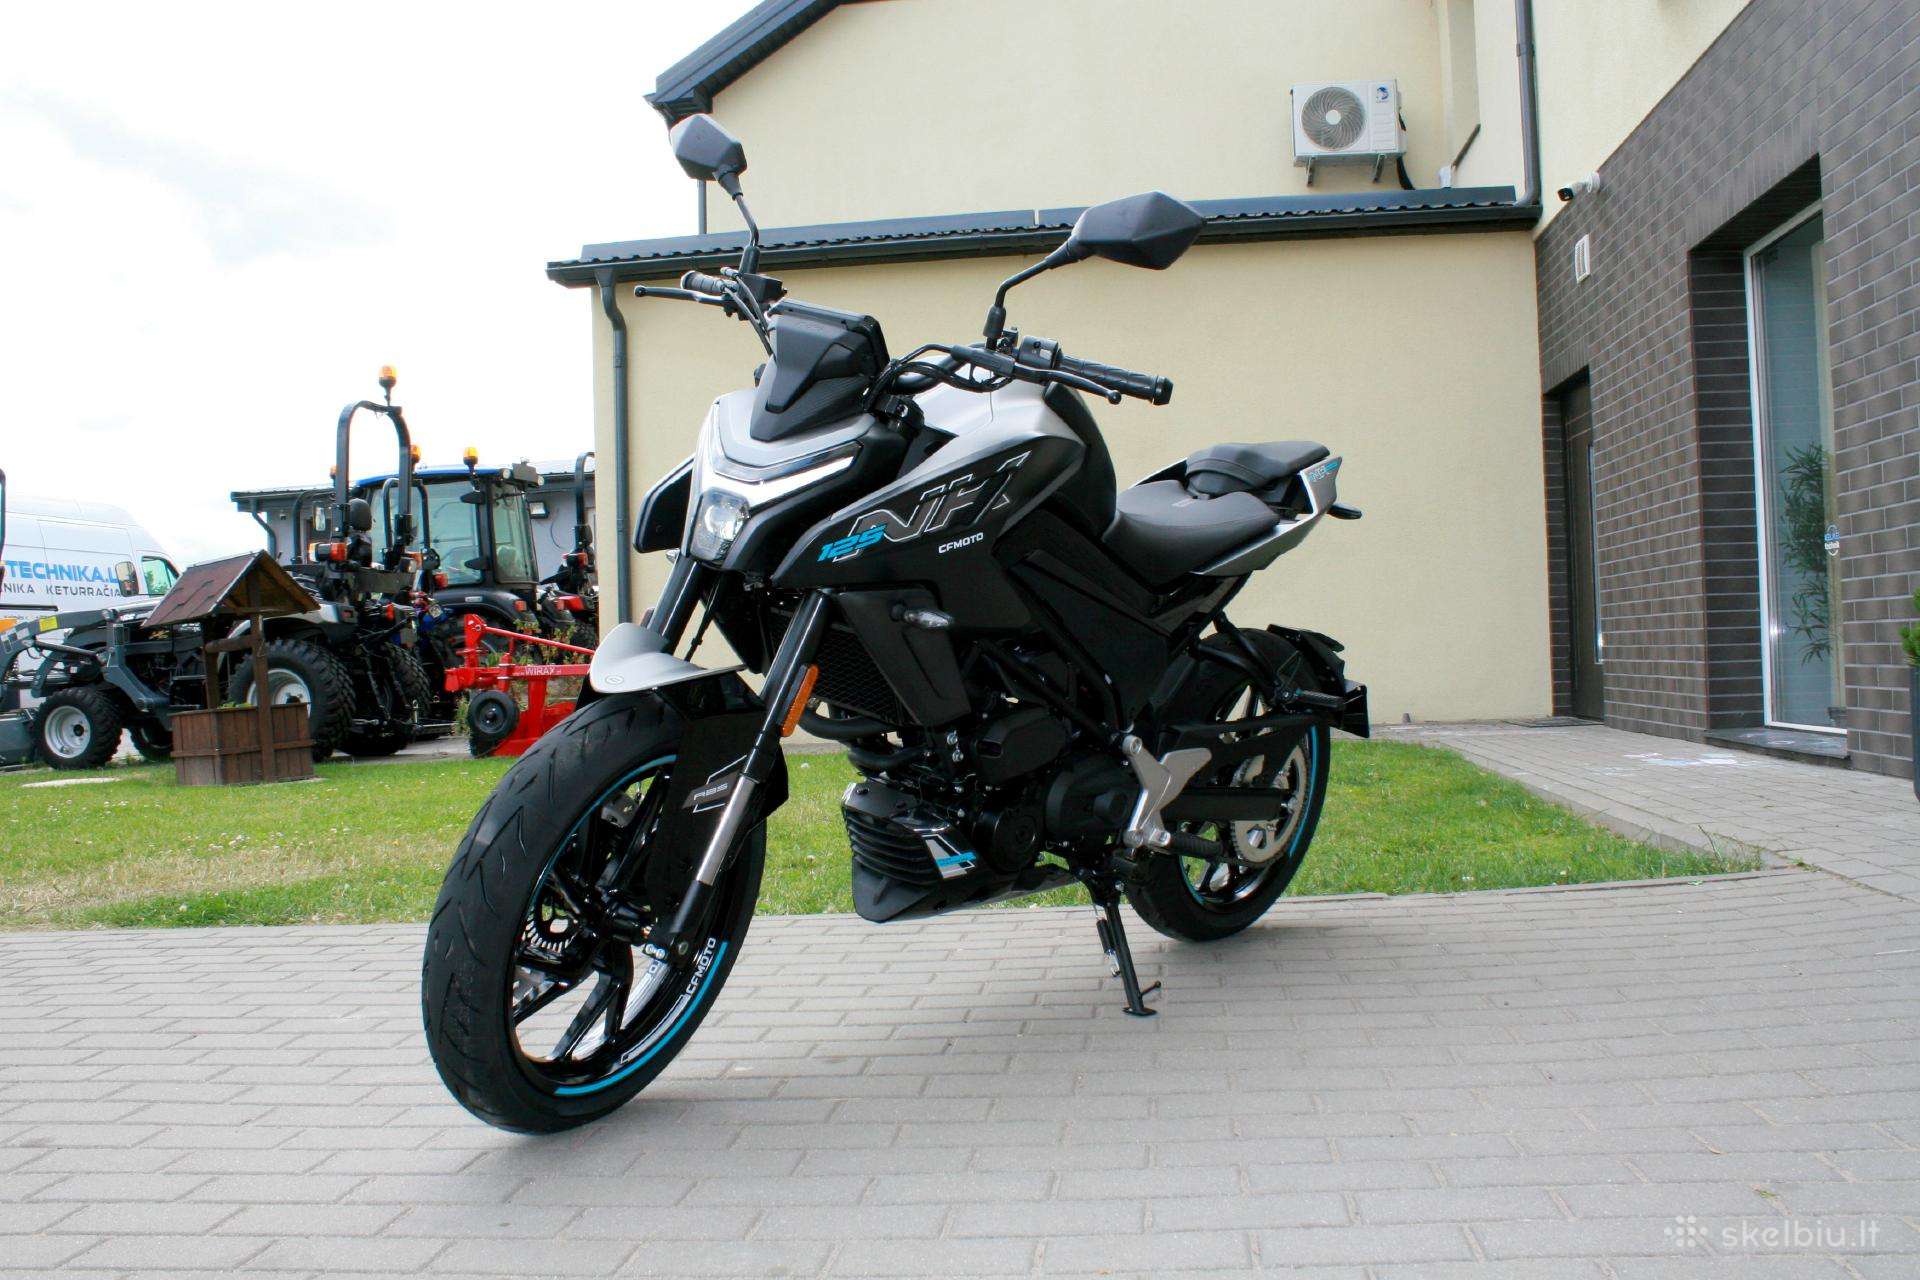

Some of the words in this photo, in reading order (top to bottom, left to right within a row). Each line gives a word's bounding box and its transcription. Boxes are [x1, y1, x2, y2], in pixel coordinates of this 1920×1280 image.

[817, 522, 888, 562] 125
[938, 532, 984, 554] CFMOTO
[694, 783, 729, 801] ABS
[685, 936, 718, 997] CFMOTO
